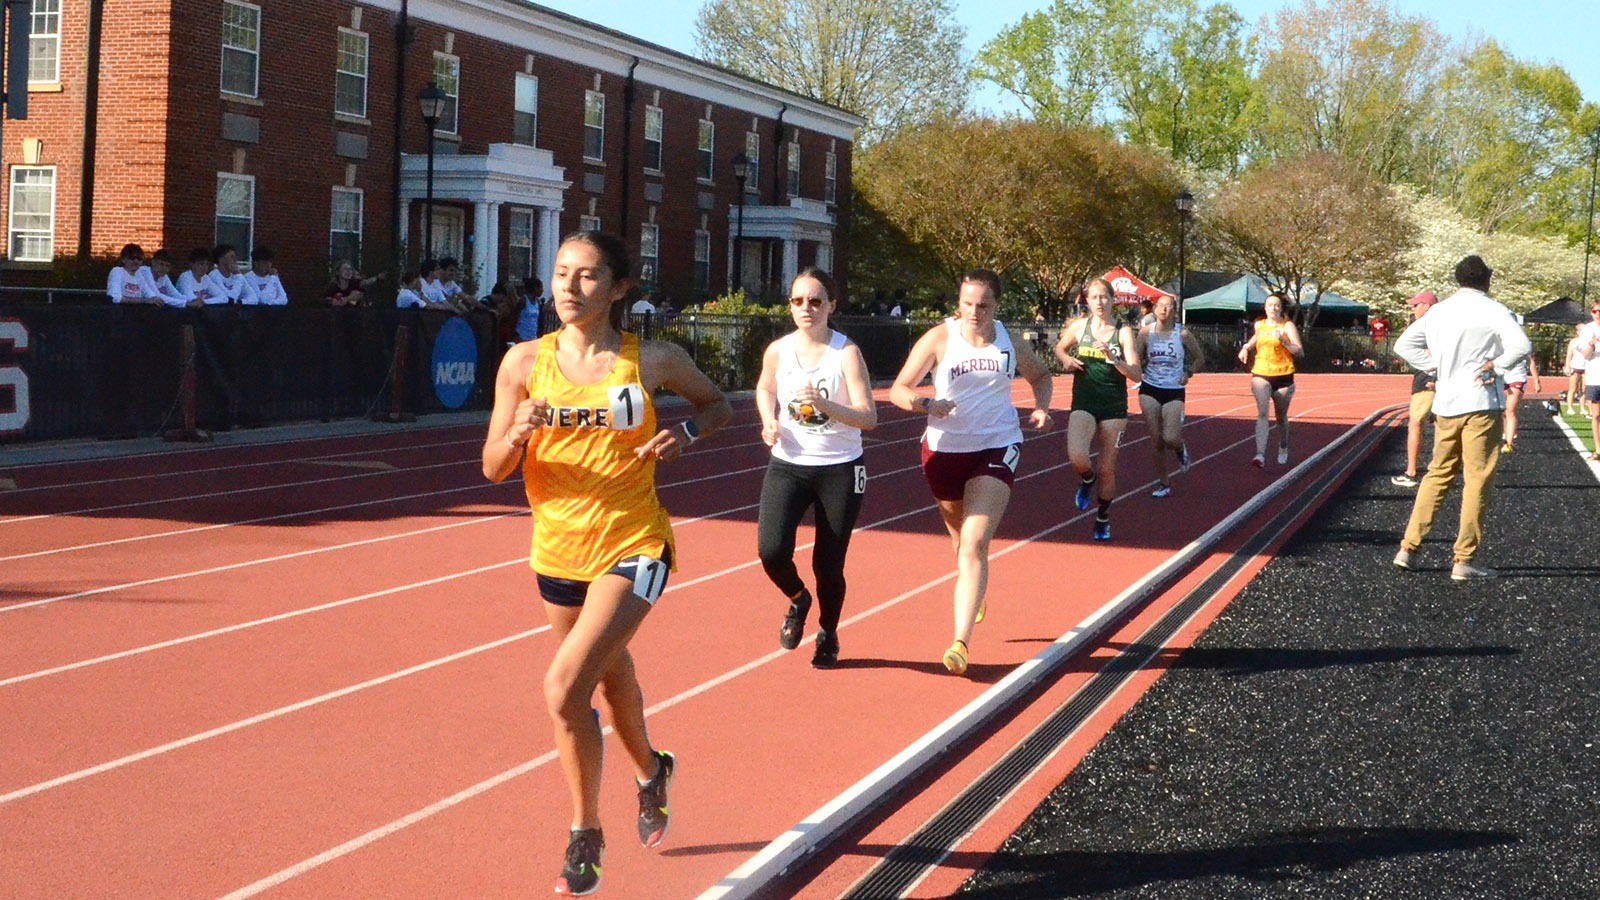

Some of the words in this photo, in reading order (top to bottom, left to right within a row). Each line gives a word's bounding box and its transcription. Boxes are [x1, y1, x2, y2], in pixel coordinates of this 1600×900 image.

[1167, 342, 1175, 356] 5
[436, 361, 475, 385] NCAA
[950, 358, 1000, 381] MEREDI
[1000, 350, 1011, 373] 7
[617, 387, 634, 427] 1
[1007, 446, 1019, 465] 7
[858, 467, 865, 492] 6
[646, 560, 660, 600] 1
